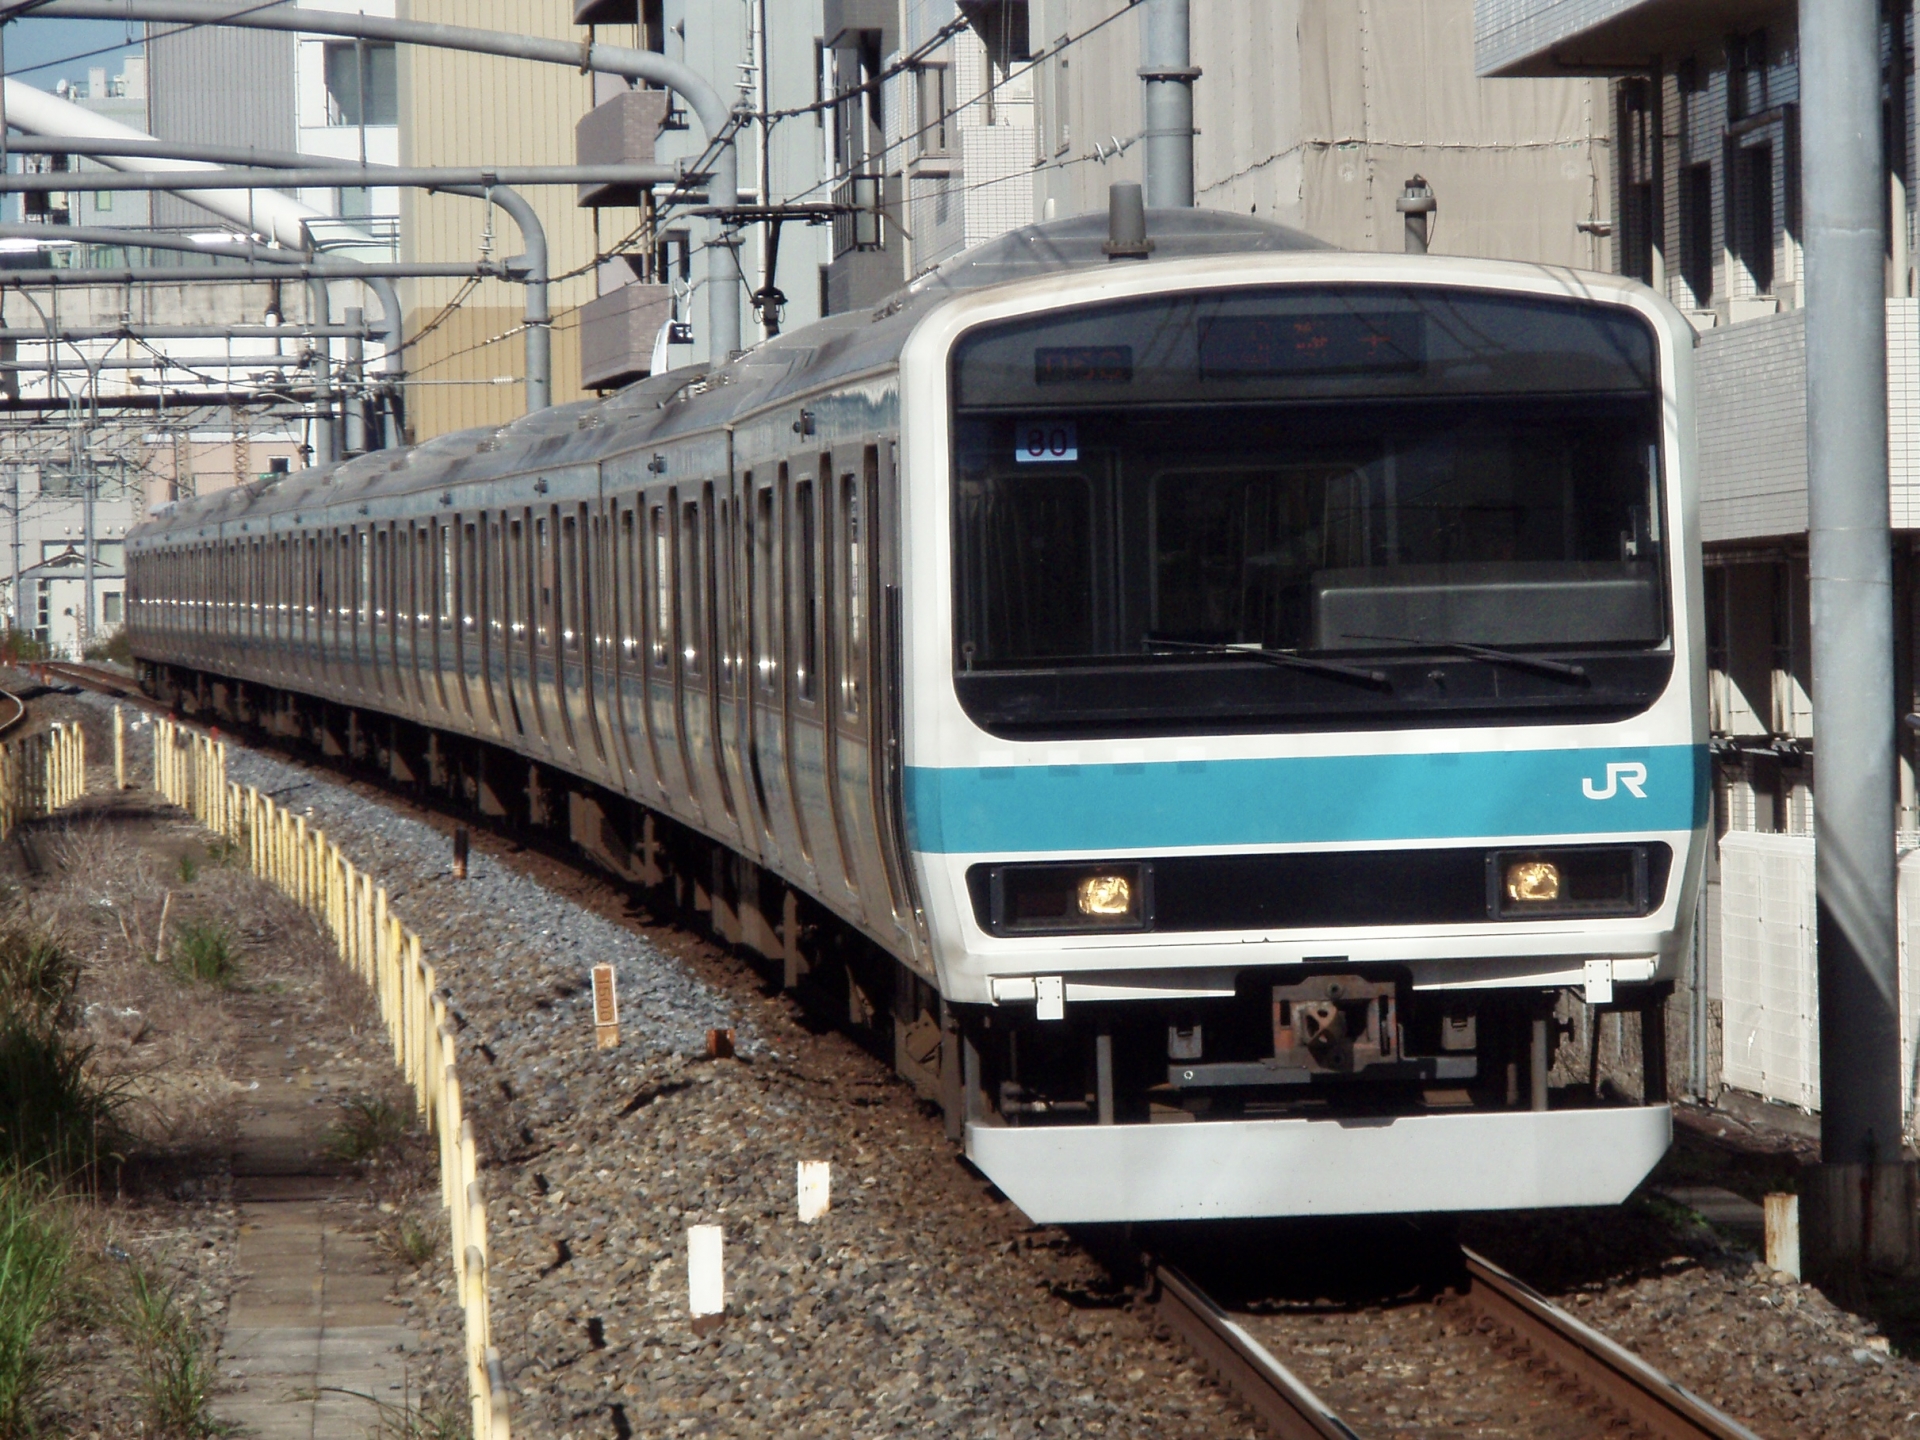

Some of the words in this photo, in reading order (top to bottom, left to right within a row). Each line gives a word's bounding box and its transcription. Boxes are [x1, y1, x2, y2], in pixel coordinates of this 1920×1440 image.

[1027, 429, 1067, 457] 80
[1582, 762, 1648, 800] JR
[596, 978, 612, 1021] 1500
